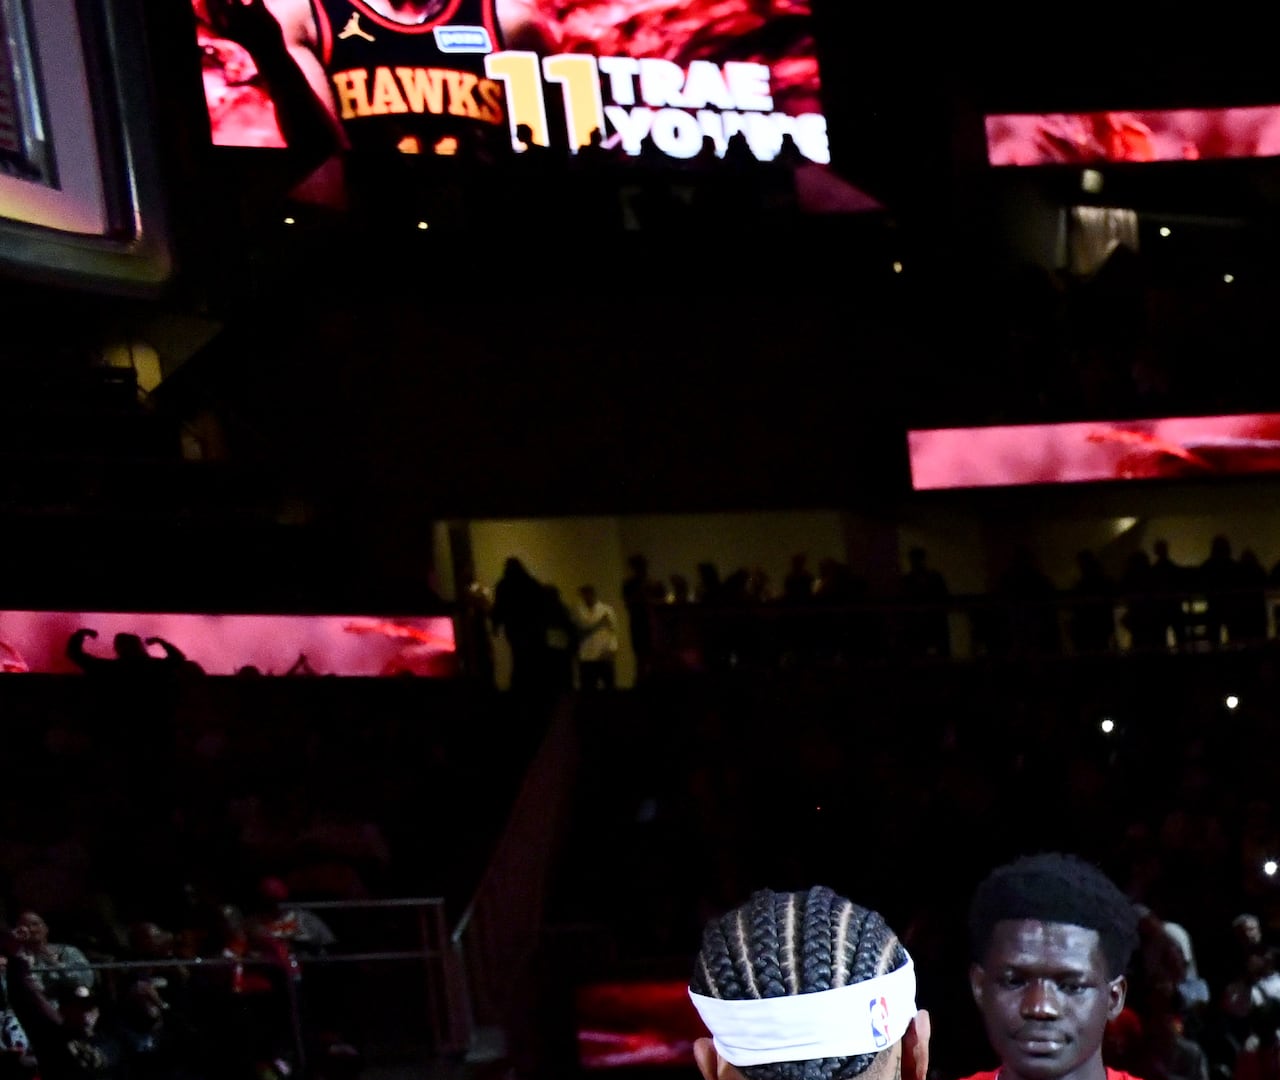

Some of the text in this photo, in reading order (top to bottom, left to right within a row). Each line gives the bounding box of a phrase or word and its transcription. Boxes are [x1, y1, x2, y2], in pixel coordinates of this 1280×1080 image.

[332, 66, 504, 126] HAWKS
[484, 50, 606, 154] 11
[598, 55, 774, 111] TRAE
